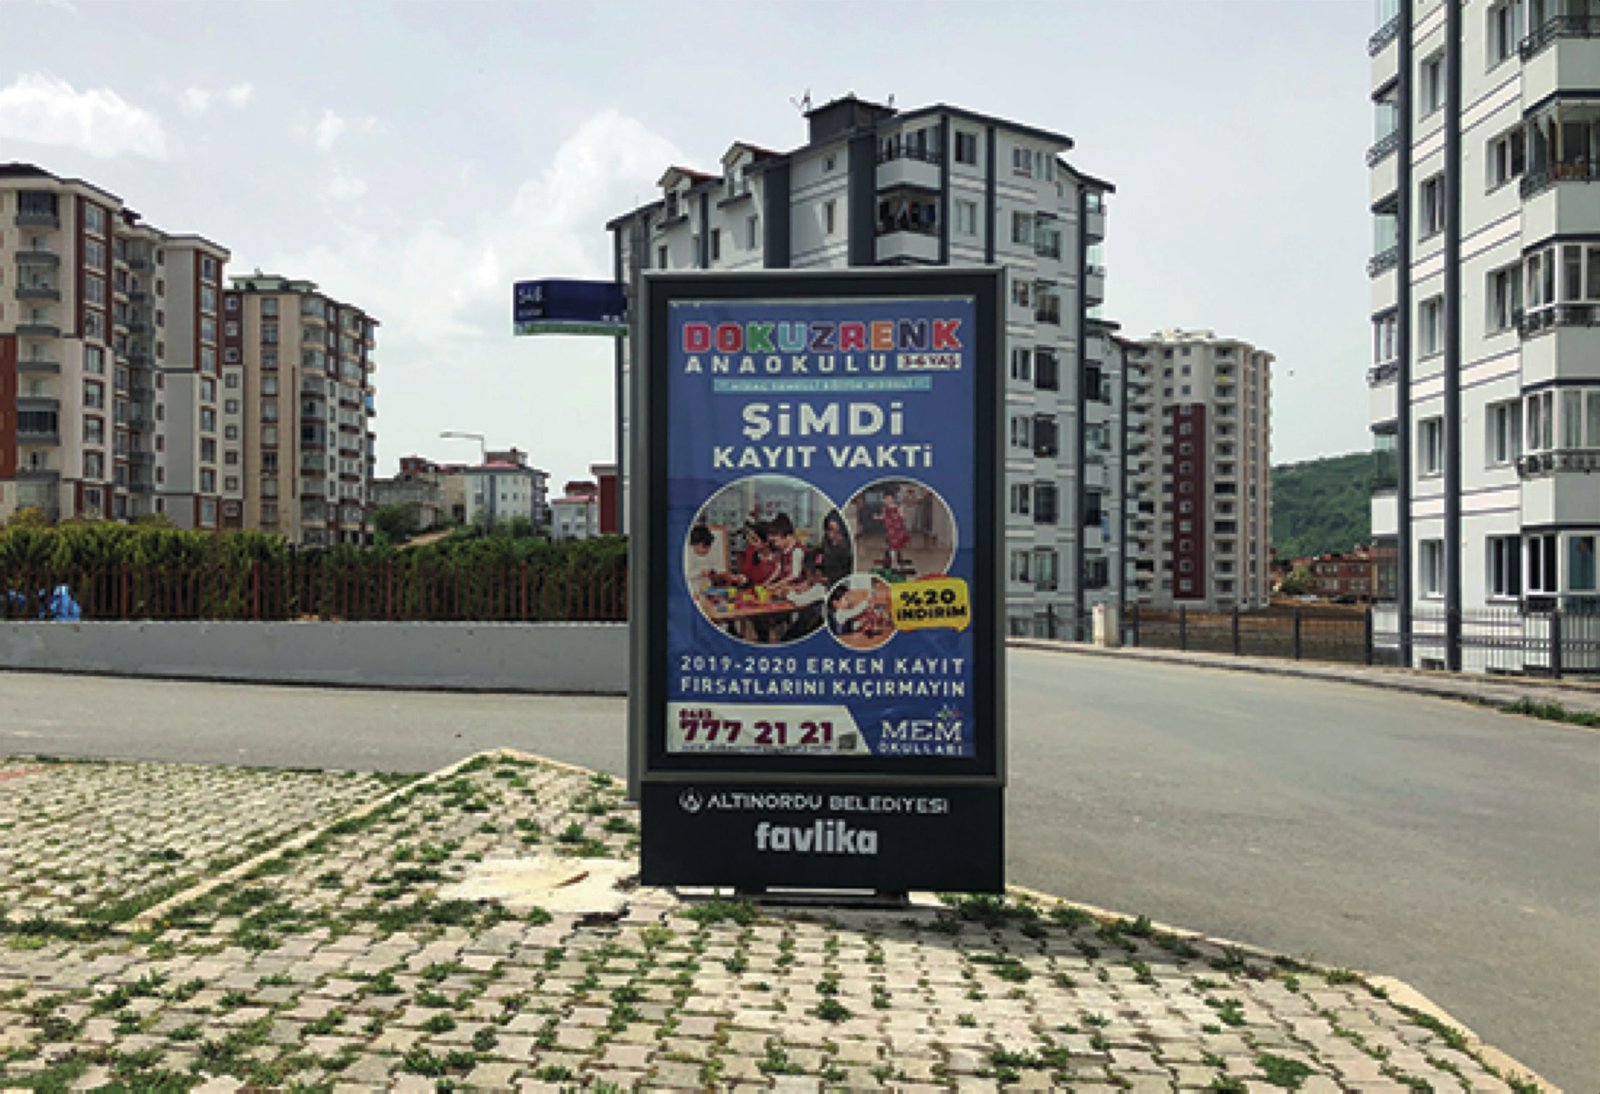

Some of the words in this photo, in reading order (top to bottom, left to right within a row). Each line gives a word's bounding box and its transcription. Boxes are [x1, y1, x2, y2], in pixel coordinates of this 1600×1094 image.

[682, 318, 963, 353] DOKUZRENK
[684, 355, 887, 374] ANAOKULU
[713, 446, 816, 468] KAYIT
[900, 588, 957, 607] %20
[679, 655, 797, 675] 2019-2020
[806, 657, 884, 675] ERKEN
[895, 658, 965, 675] KAYIT
[680, 676, 825, 695] FIRSATLARINI
[832, 679, 966, 698] KAÇIRMAYIN
[679, 719, 742, 742] 777
[754, 721, 788, 744] 21
[800, 721, 833, 744] 21
[882, 719, 962, 741] MEM
[706, 792, 823, 811] ALTINORDU
[755, 818, 878, 854] favlika
